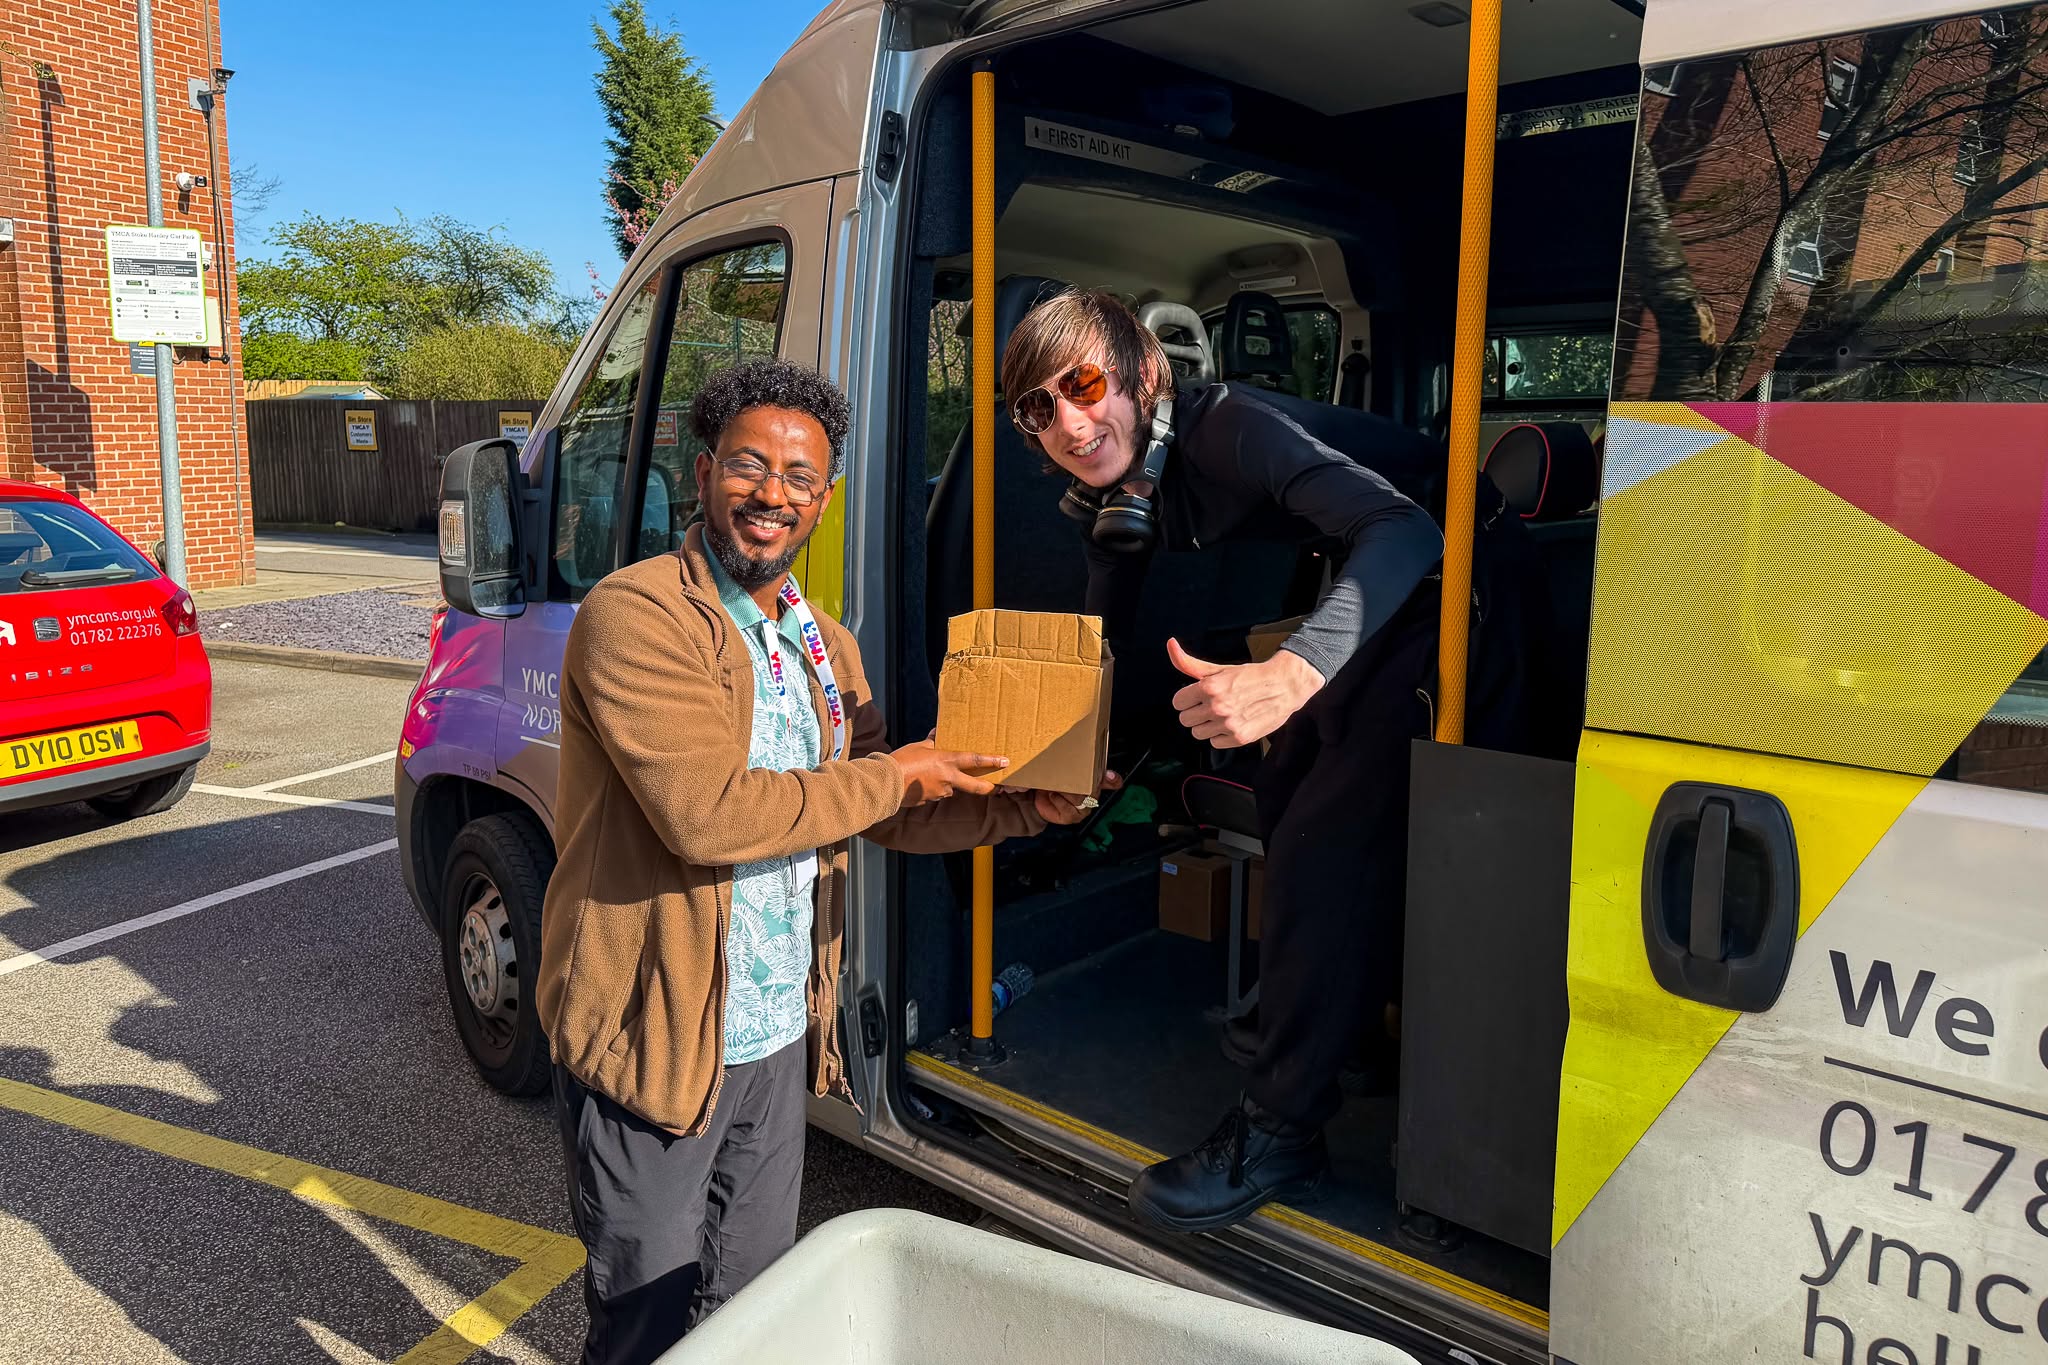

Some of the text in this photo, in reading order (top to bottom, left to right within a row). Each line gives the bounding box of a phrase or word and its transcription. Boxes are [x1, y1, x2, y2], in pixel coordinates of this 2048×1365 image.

[1525, 115, 1575, 130] SEATED
[1603, 106, 1639, 119] WHE
[1586, 96, 1639, 110] SEATED
[1048, 127, 1132, 160] FIRST AID KIT
[502, 417, 529, 425] Bin Store
[66, 605, 158, 630] ymcans.org.uk
[70, 623, 162, 646] 01782 222376
[802, 620, 825, 666] YMCA
[11, 664, 93, 682] IBIZA
[521, 667, 561, 699] YMC
[824, 683, 842, 728] YMCA
[10, 726, 126, 770] DY10 OSW
[1829, 949, 1995, 1056] We
[1799, 1211, 2048, 1346] ymc
